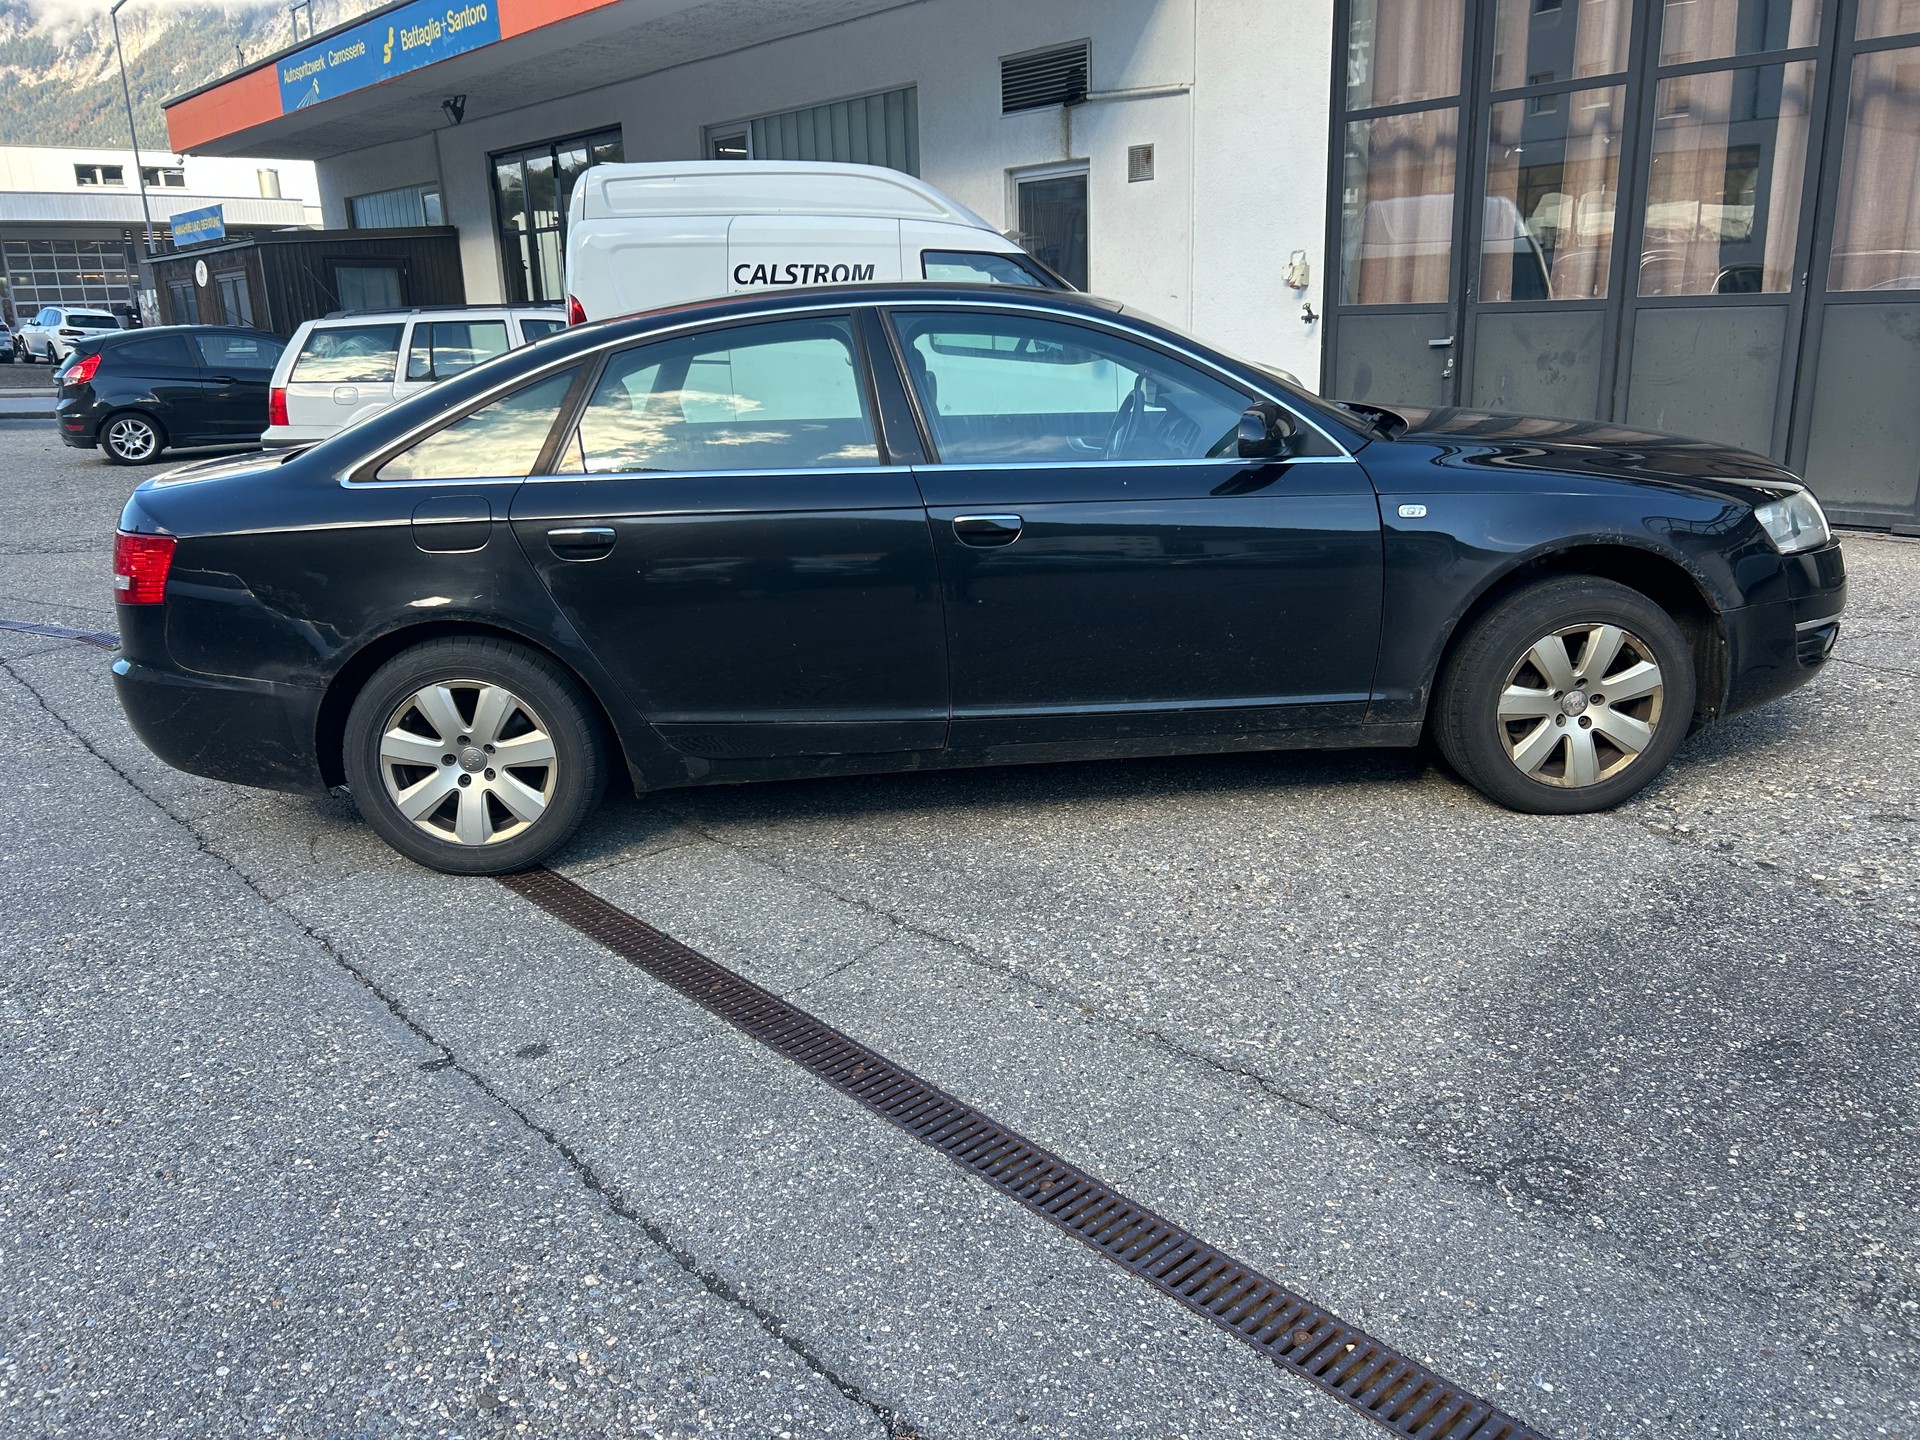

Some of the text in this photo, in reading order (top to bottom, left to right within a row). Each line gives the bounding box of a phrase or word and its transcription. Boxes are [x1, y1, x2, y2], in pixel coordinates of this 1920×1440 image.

[284, 39, 366, 84] Autospritzwerk Carrosserie
[733, 263, 875, 285] CALSTROM
